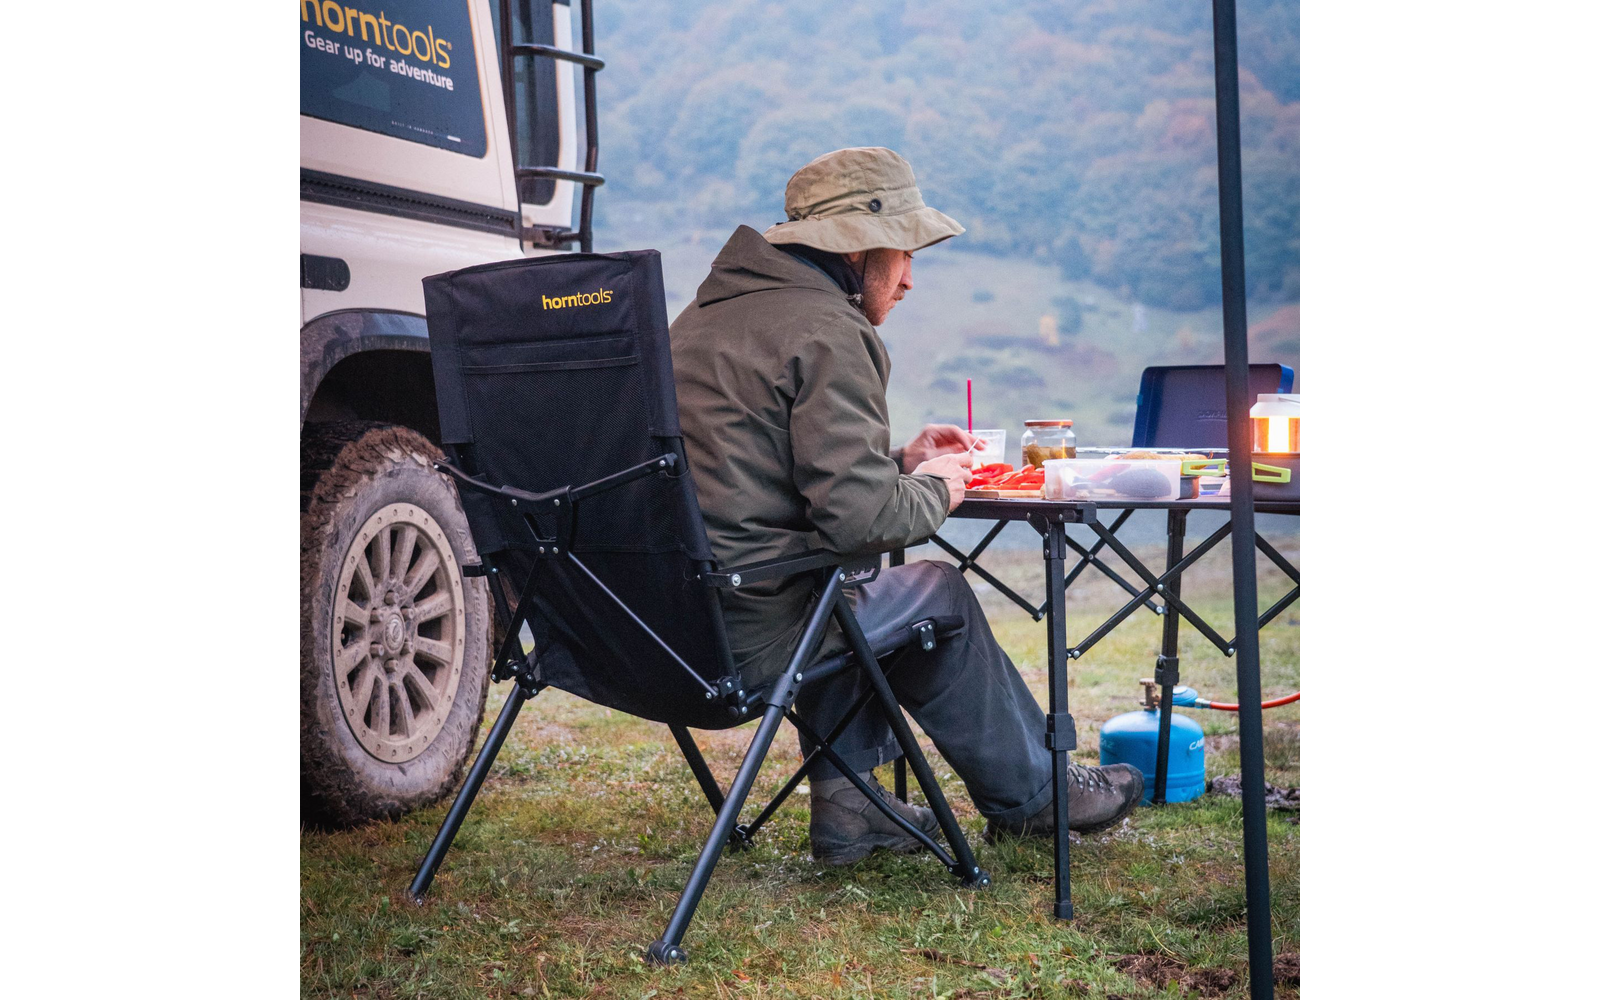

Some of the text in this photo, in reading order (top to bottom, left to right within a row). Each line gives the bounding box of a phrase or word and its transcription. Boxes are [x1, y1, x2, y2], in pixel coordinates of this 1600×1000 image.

[305, 30, 454, 91] Gear up for adventure
[541, 287, 612, 310] horntools
